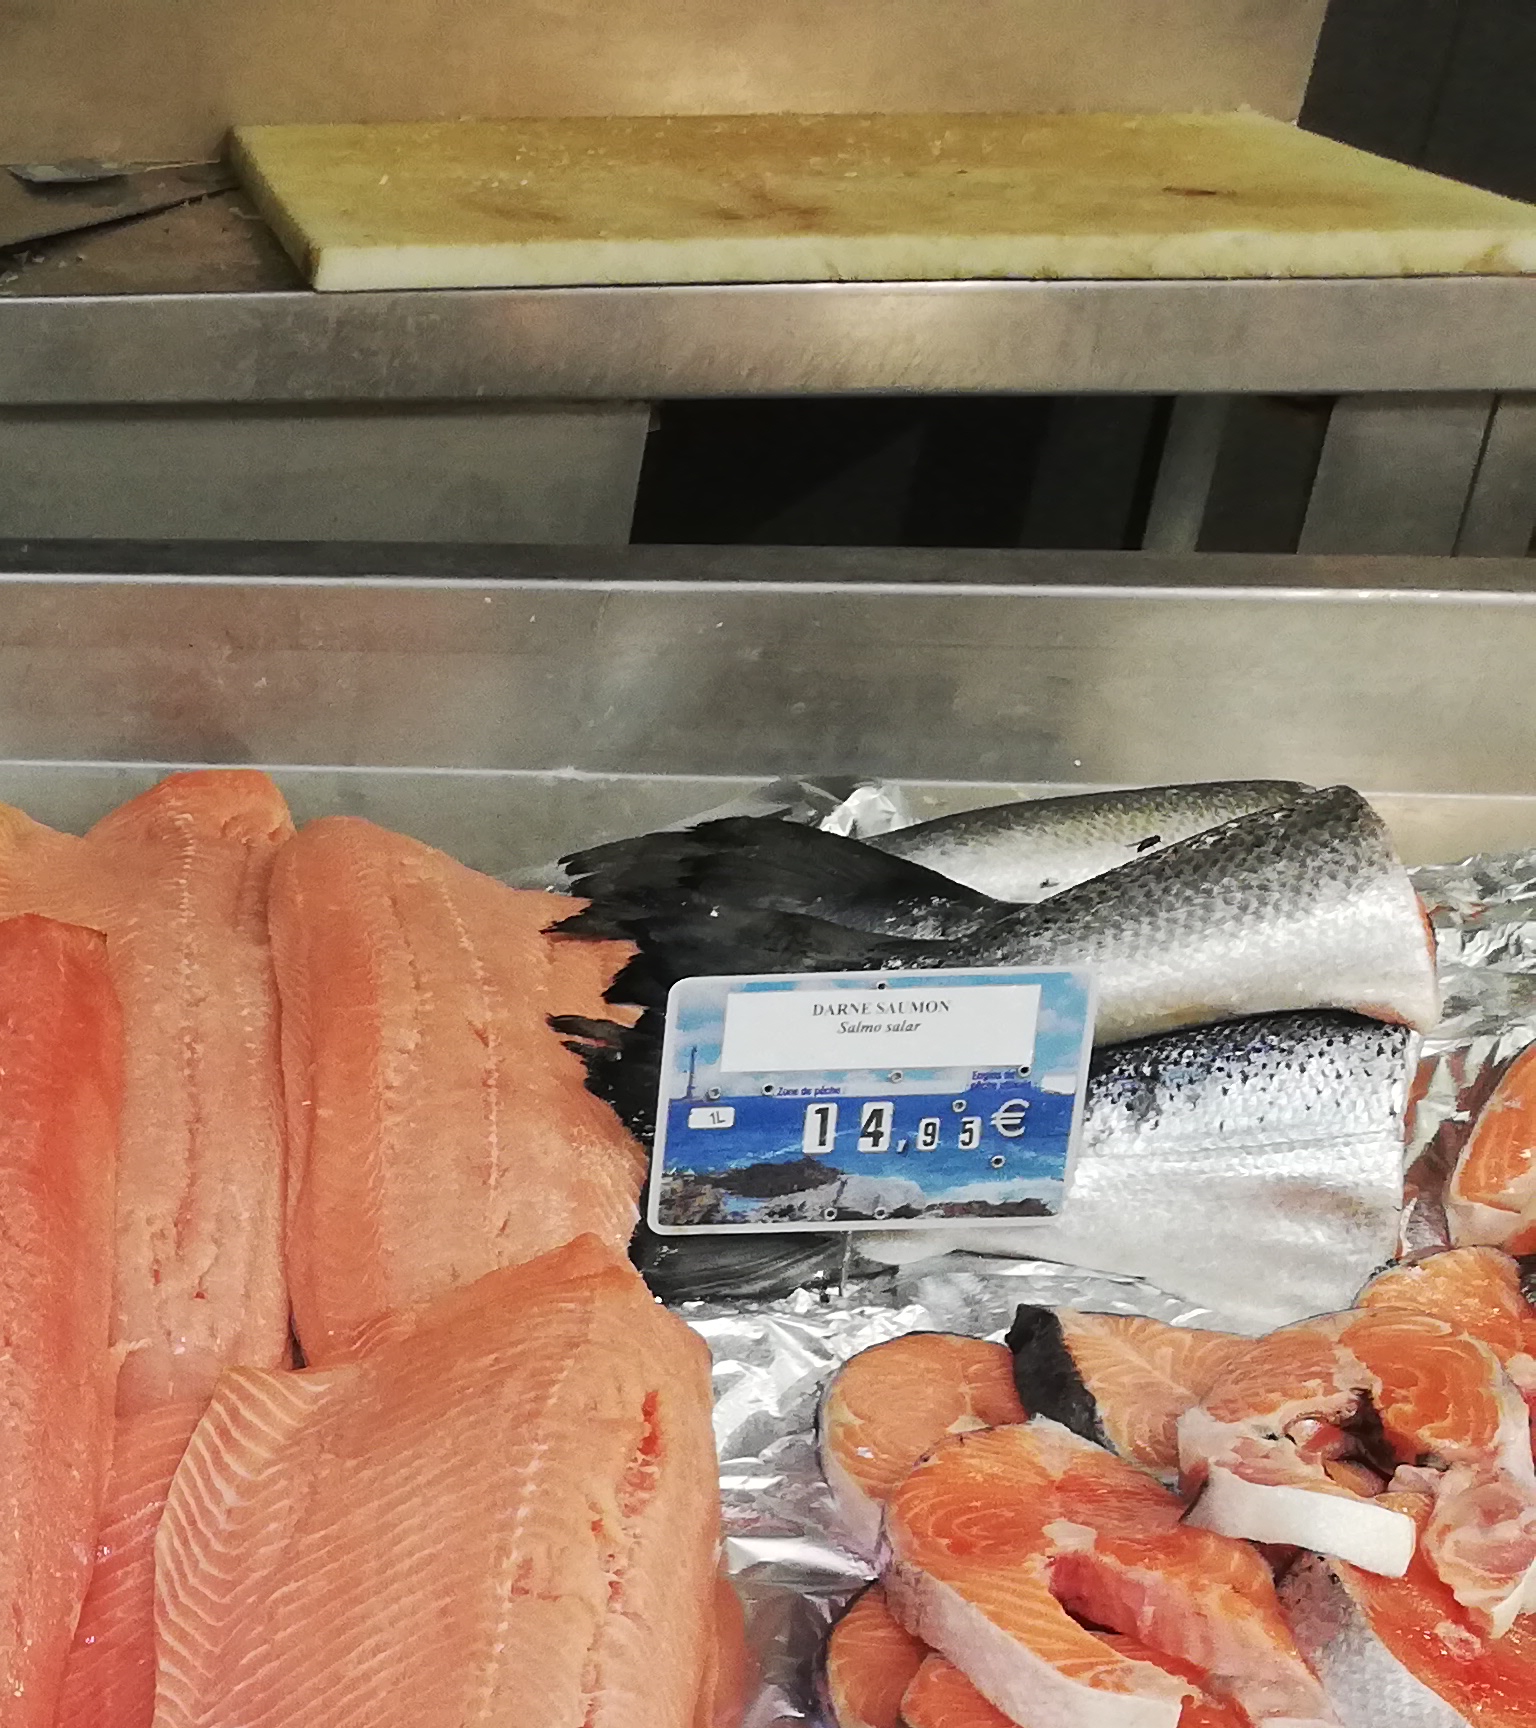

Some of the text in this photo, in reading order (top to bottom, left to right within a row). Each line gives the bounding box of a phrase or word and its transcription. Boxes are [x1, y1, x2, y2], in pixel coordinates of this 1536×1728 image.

[812, 1000, 951, 1016] DARNE SAUMON
[837, 1019, 922, 1034] Salmo salar
